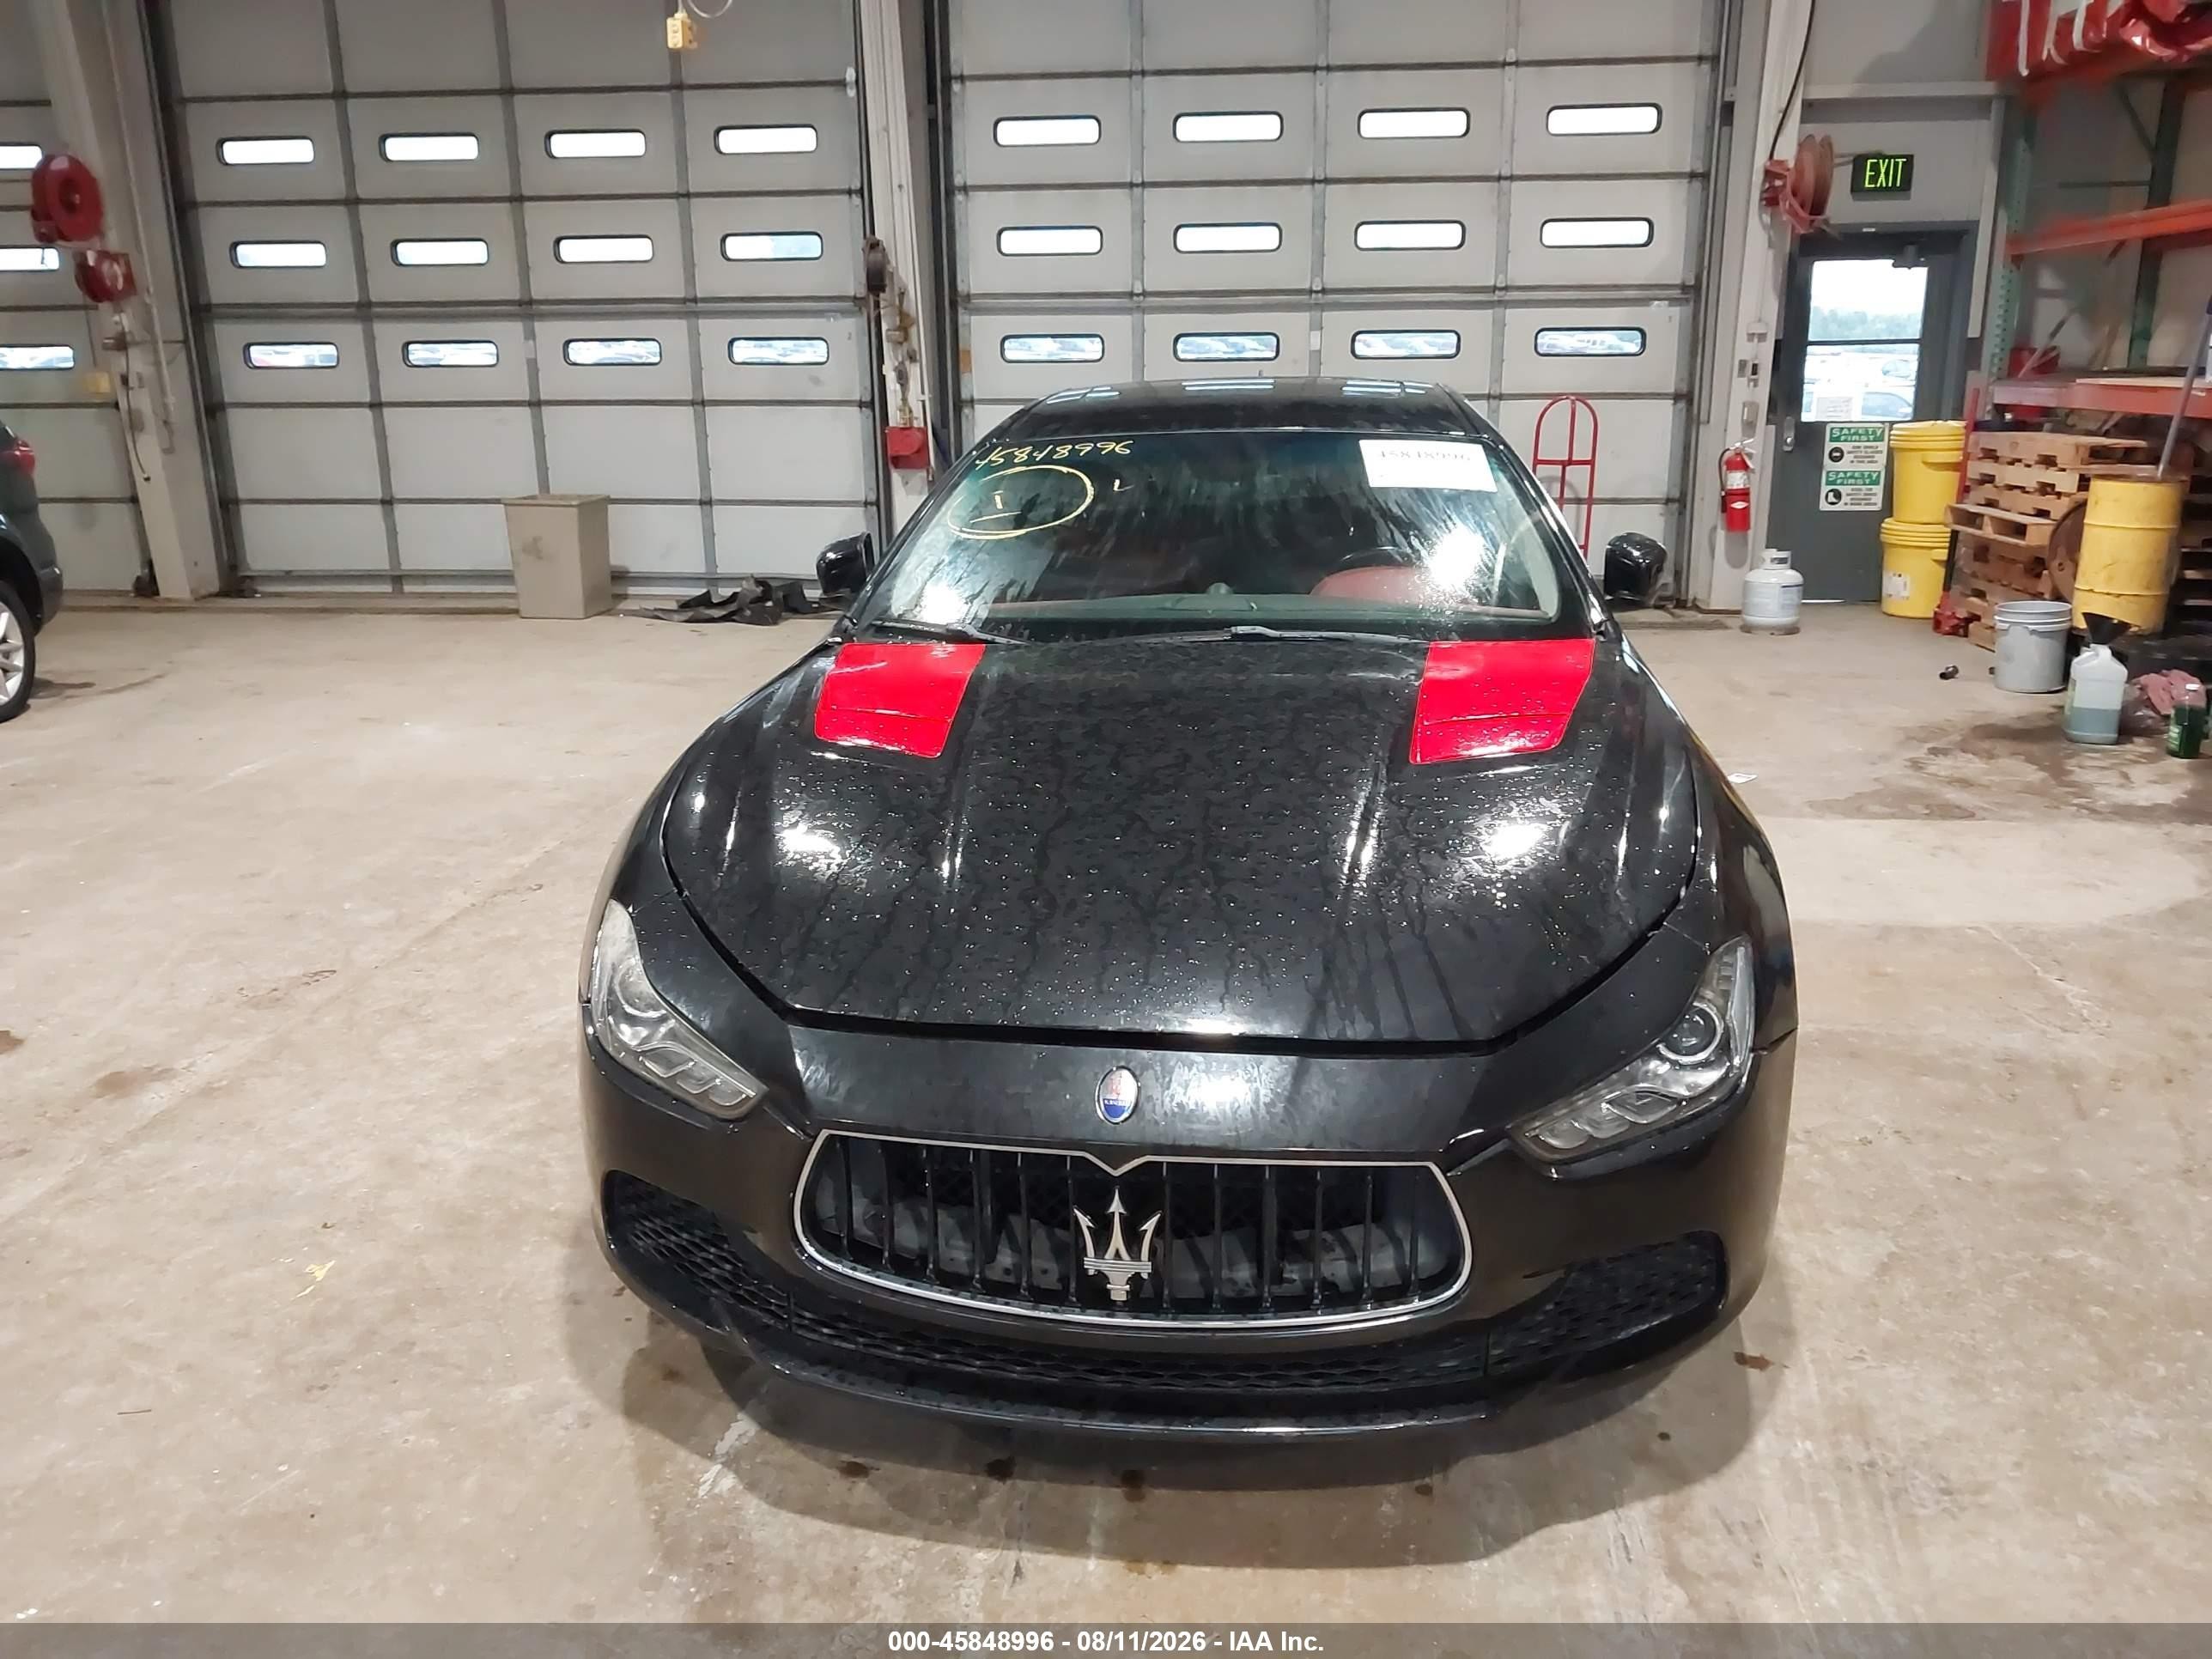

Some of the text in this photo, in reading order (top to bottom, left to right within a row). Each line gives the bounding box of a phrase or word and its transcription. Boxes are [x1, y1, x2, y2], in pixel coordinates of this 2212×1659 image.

[1864, 158, 1907, 187] EXIT
[1831, 428, 1883, 437] SAFETY
[975, 441, 1133, 471] 45848996
[1827, 471, 1880, 480] SAFETY
